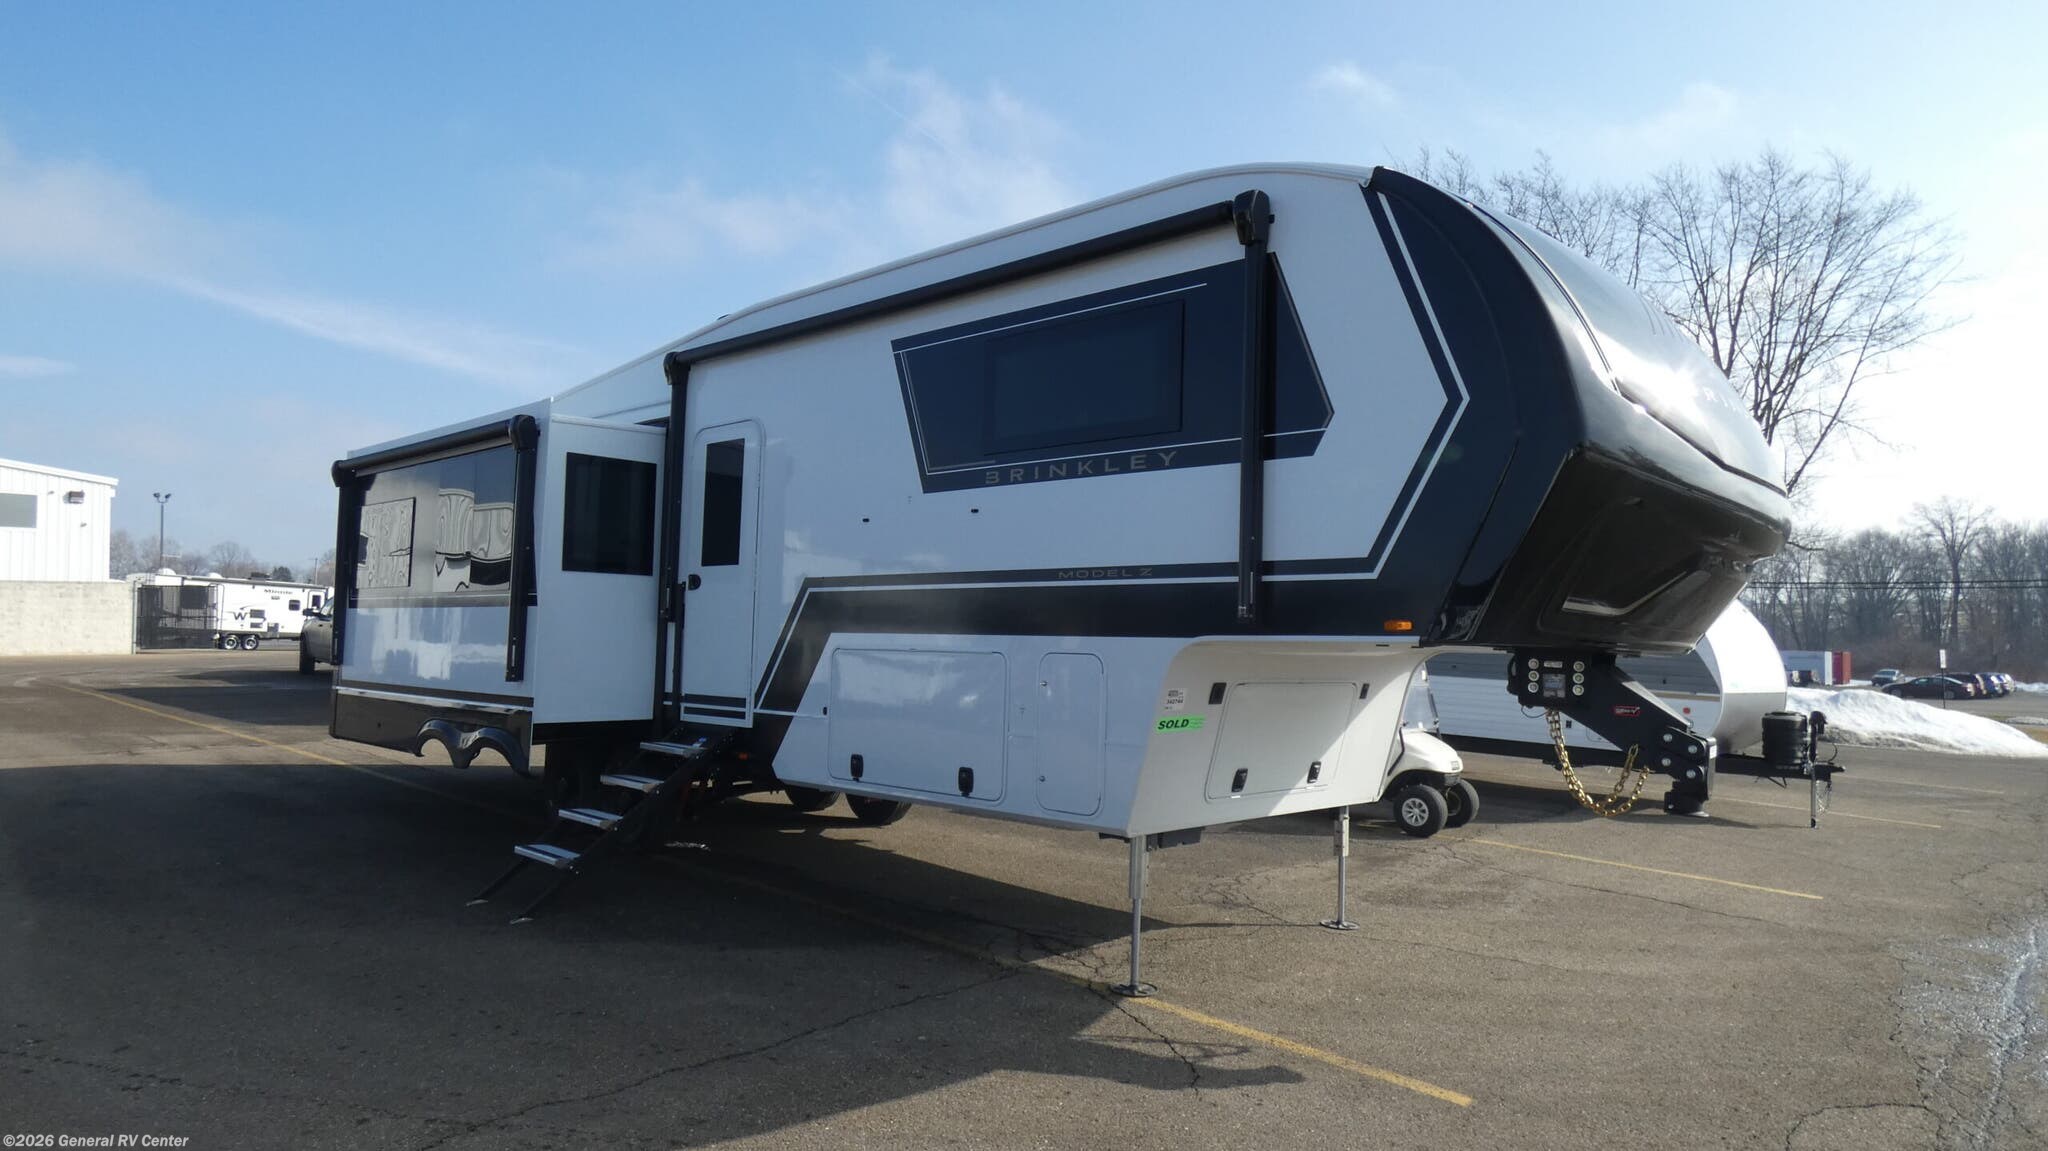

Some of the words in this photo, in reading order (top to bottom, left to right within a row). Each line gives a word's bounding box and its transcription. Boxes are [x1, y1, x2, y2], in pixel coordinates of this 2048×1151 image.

[984, 451, 1177, 485] BRINKLEY
[1058, 568, 1133, 580] MODEL
[1140, 567, 1153, 577] Z
[1157, 719, 1190, 730] SOLD
